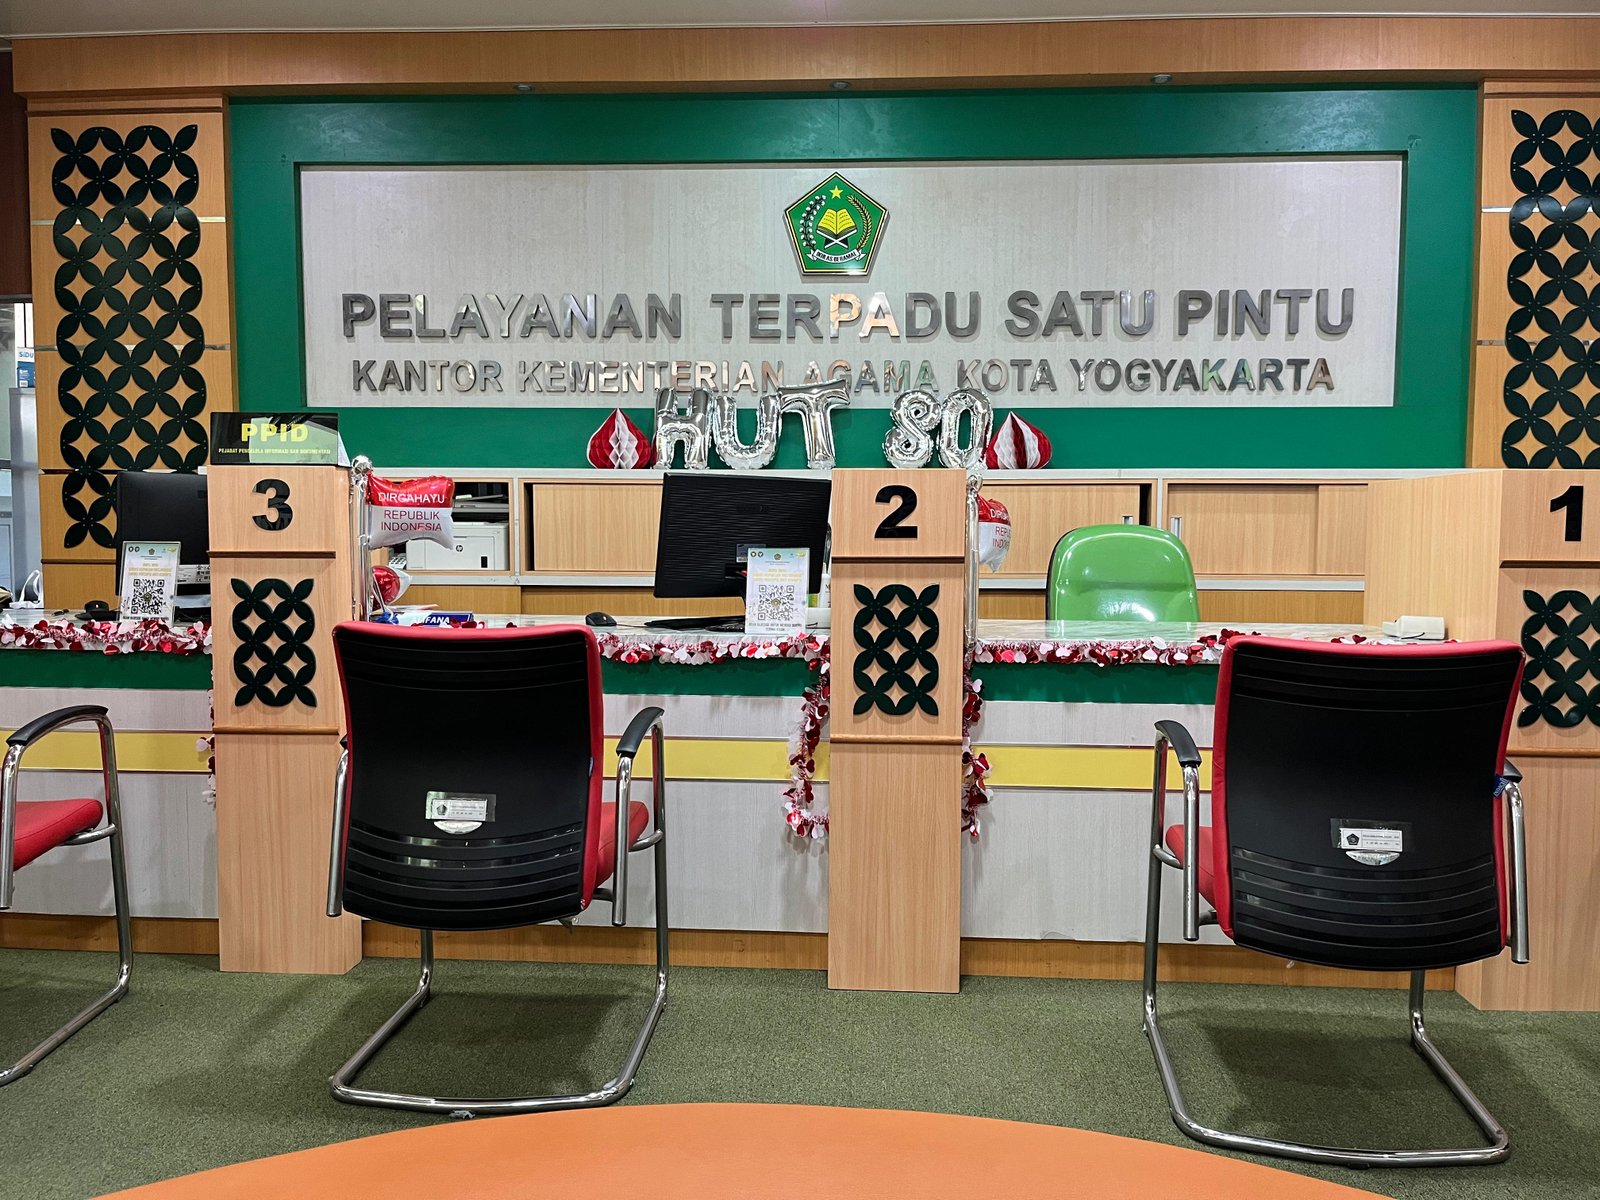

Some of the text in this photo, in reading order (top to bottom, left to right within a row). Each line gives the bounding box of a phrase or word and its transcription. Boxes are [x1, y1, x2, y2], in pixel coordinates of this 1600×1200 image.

[341, 287, 1354, 339] PELAYANAN TERPADU SATU PINTU
[351, 357, 1335, 394] KANTOR KEMENTERIAN AGAMA KOTA YOGYAKARTA
[241, 423, 309, 442] PPID
[653, 379, 994, 469] HUT 80
[252, 478, 294, 531] 3
[378, 491, 446, 504] DIRGAHAYU
[384, 509, 440, 521] REPUBLIK
[873, 484, 919, 539] 2
[1549, 485, 1584, 542] 1
[380, 520, 443, 533] INDONESIA
